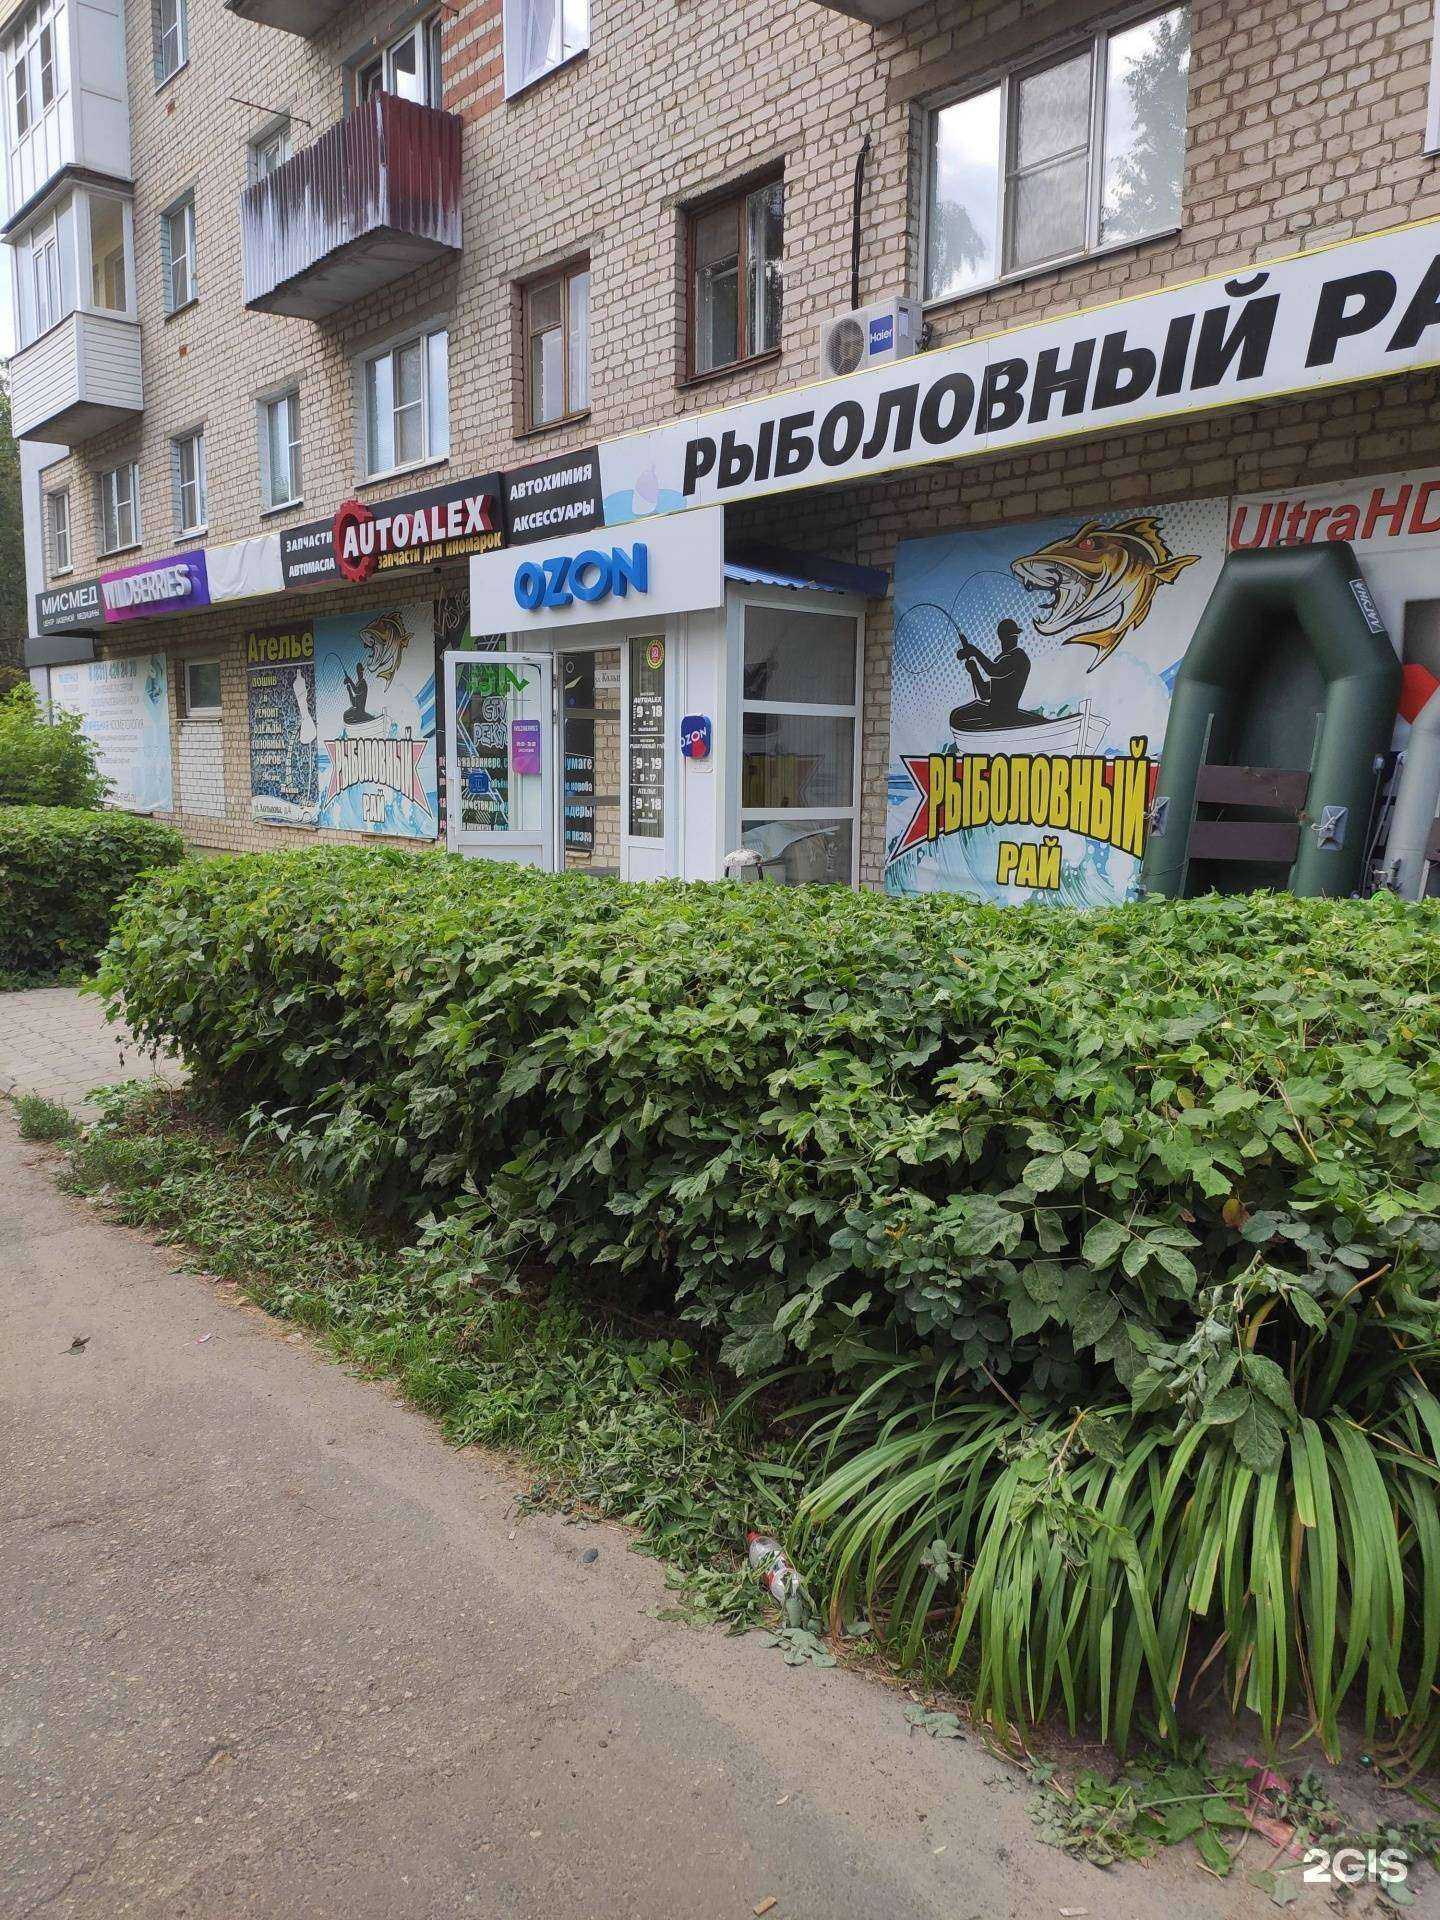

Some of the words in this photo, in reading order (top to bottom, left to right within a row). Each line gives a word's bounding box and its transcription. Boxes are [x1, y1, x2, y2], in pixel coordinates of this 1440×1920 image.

[870, 328, 893, 343] Haier
[683, 272, 1281, 497] РЫБОЛОВНЫЙ
[510, 464, 593, 500] АВТОХИМИЯ
[342, 494, 487, 559] AUTOALEX
[512, 499, 595, 533] АКСЕССУАРЫ
[286, 530, 333, 553] ЗАПЧАСТИ
[378, 547, 421, 569] запчасти
[423, 542, 443, 564] для
[446, 531, 503, 557] иномарок
[288, 556, 336, 578] АВТОМАСЛА
[513, 542, 648, 611] OZON
[41, 585, 98, 616] МИСМЕД
[101, 563, 192, 610] WILDBERRIES
[248, 632, 314, 662] Ателье
[254, 707, 280, 719] РЕМОНТ
[636, 705, 644, 718] 9
[652, 705, 663, 718] 18
[680, 727, 707, 748] OZON
[335, 726, 414, 804] РЫБОЛОВНЫЙ
[566, 757, 593, 771] умаге
[636, 757, 643, 769] 9
[651, 757, 662, 770] 19
[362, 789, 386, 823] РАЙ
[636, 797, 643, 810] 9
[651, 798, 662, 811] 18
[926, 736, 1150, 861] РЫБОЛОВНЫЙ
[996, 835, 1063, 890] РАЙ
